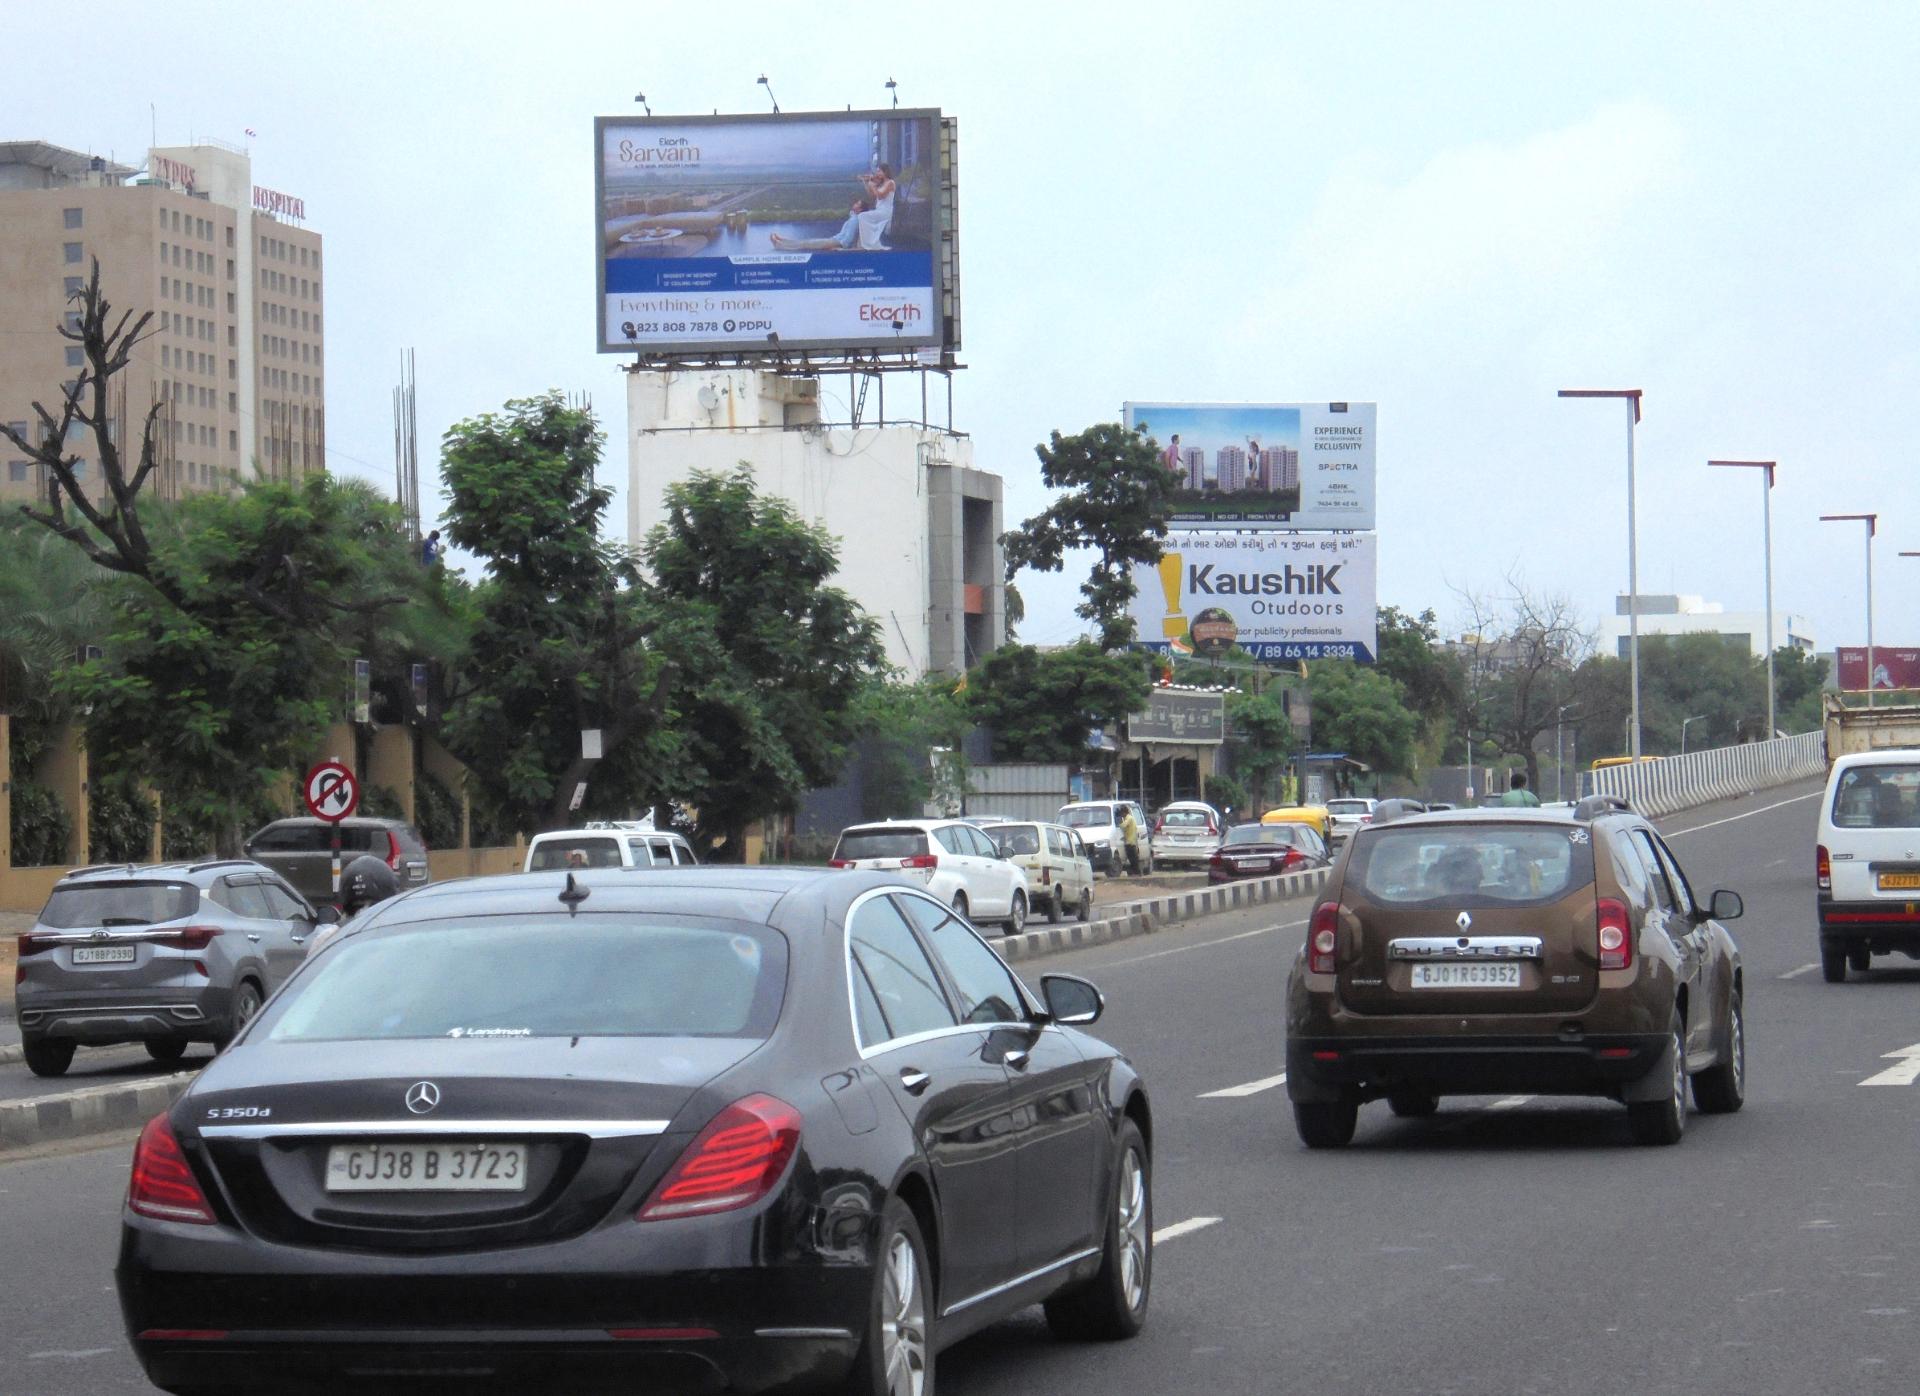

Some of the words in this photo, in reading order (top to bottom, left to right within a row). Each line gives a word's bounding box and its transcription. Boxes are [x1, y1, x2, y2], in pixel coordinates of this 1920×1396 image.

[619, 140, 700, 162] Sarvam
[253, 185, 306, 219] HOSPITAL
[620, 298, 699, 314] Everything
[860, 303, 921, 320] Ekarth
[637, 322, 658, 332] 823
[663, 322, 686, 332] 808
[690, 321, 718, 332] 7878
[739, 320, 772, 331] PDPU
[1314, 427, 1363, 435] EXPERIENCE
[1314, 442, 1362, 450] EXCLUSIVITY
[1318, 463, 1358, 471] SPECTRA
[1189, 564, 1342, 595] KaushiK
[1251, 600, 1344, 616] Otudoors
[1254, 626, 1289, 639] publicity
[1291, 626, 1342, 639] professionals
[1285, 645, 1301, 657] 66
[1304, 645, 1319, 657] 14
[1323, 645, 1355, 657] 3334
[348, 1150, 413, 1180] GJ38
[424, 1151, 439, 1180] B
[451, 1150, 519, 1179] 3723
